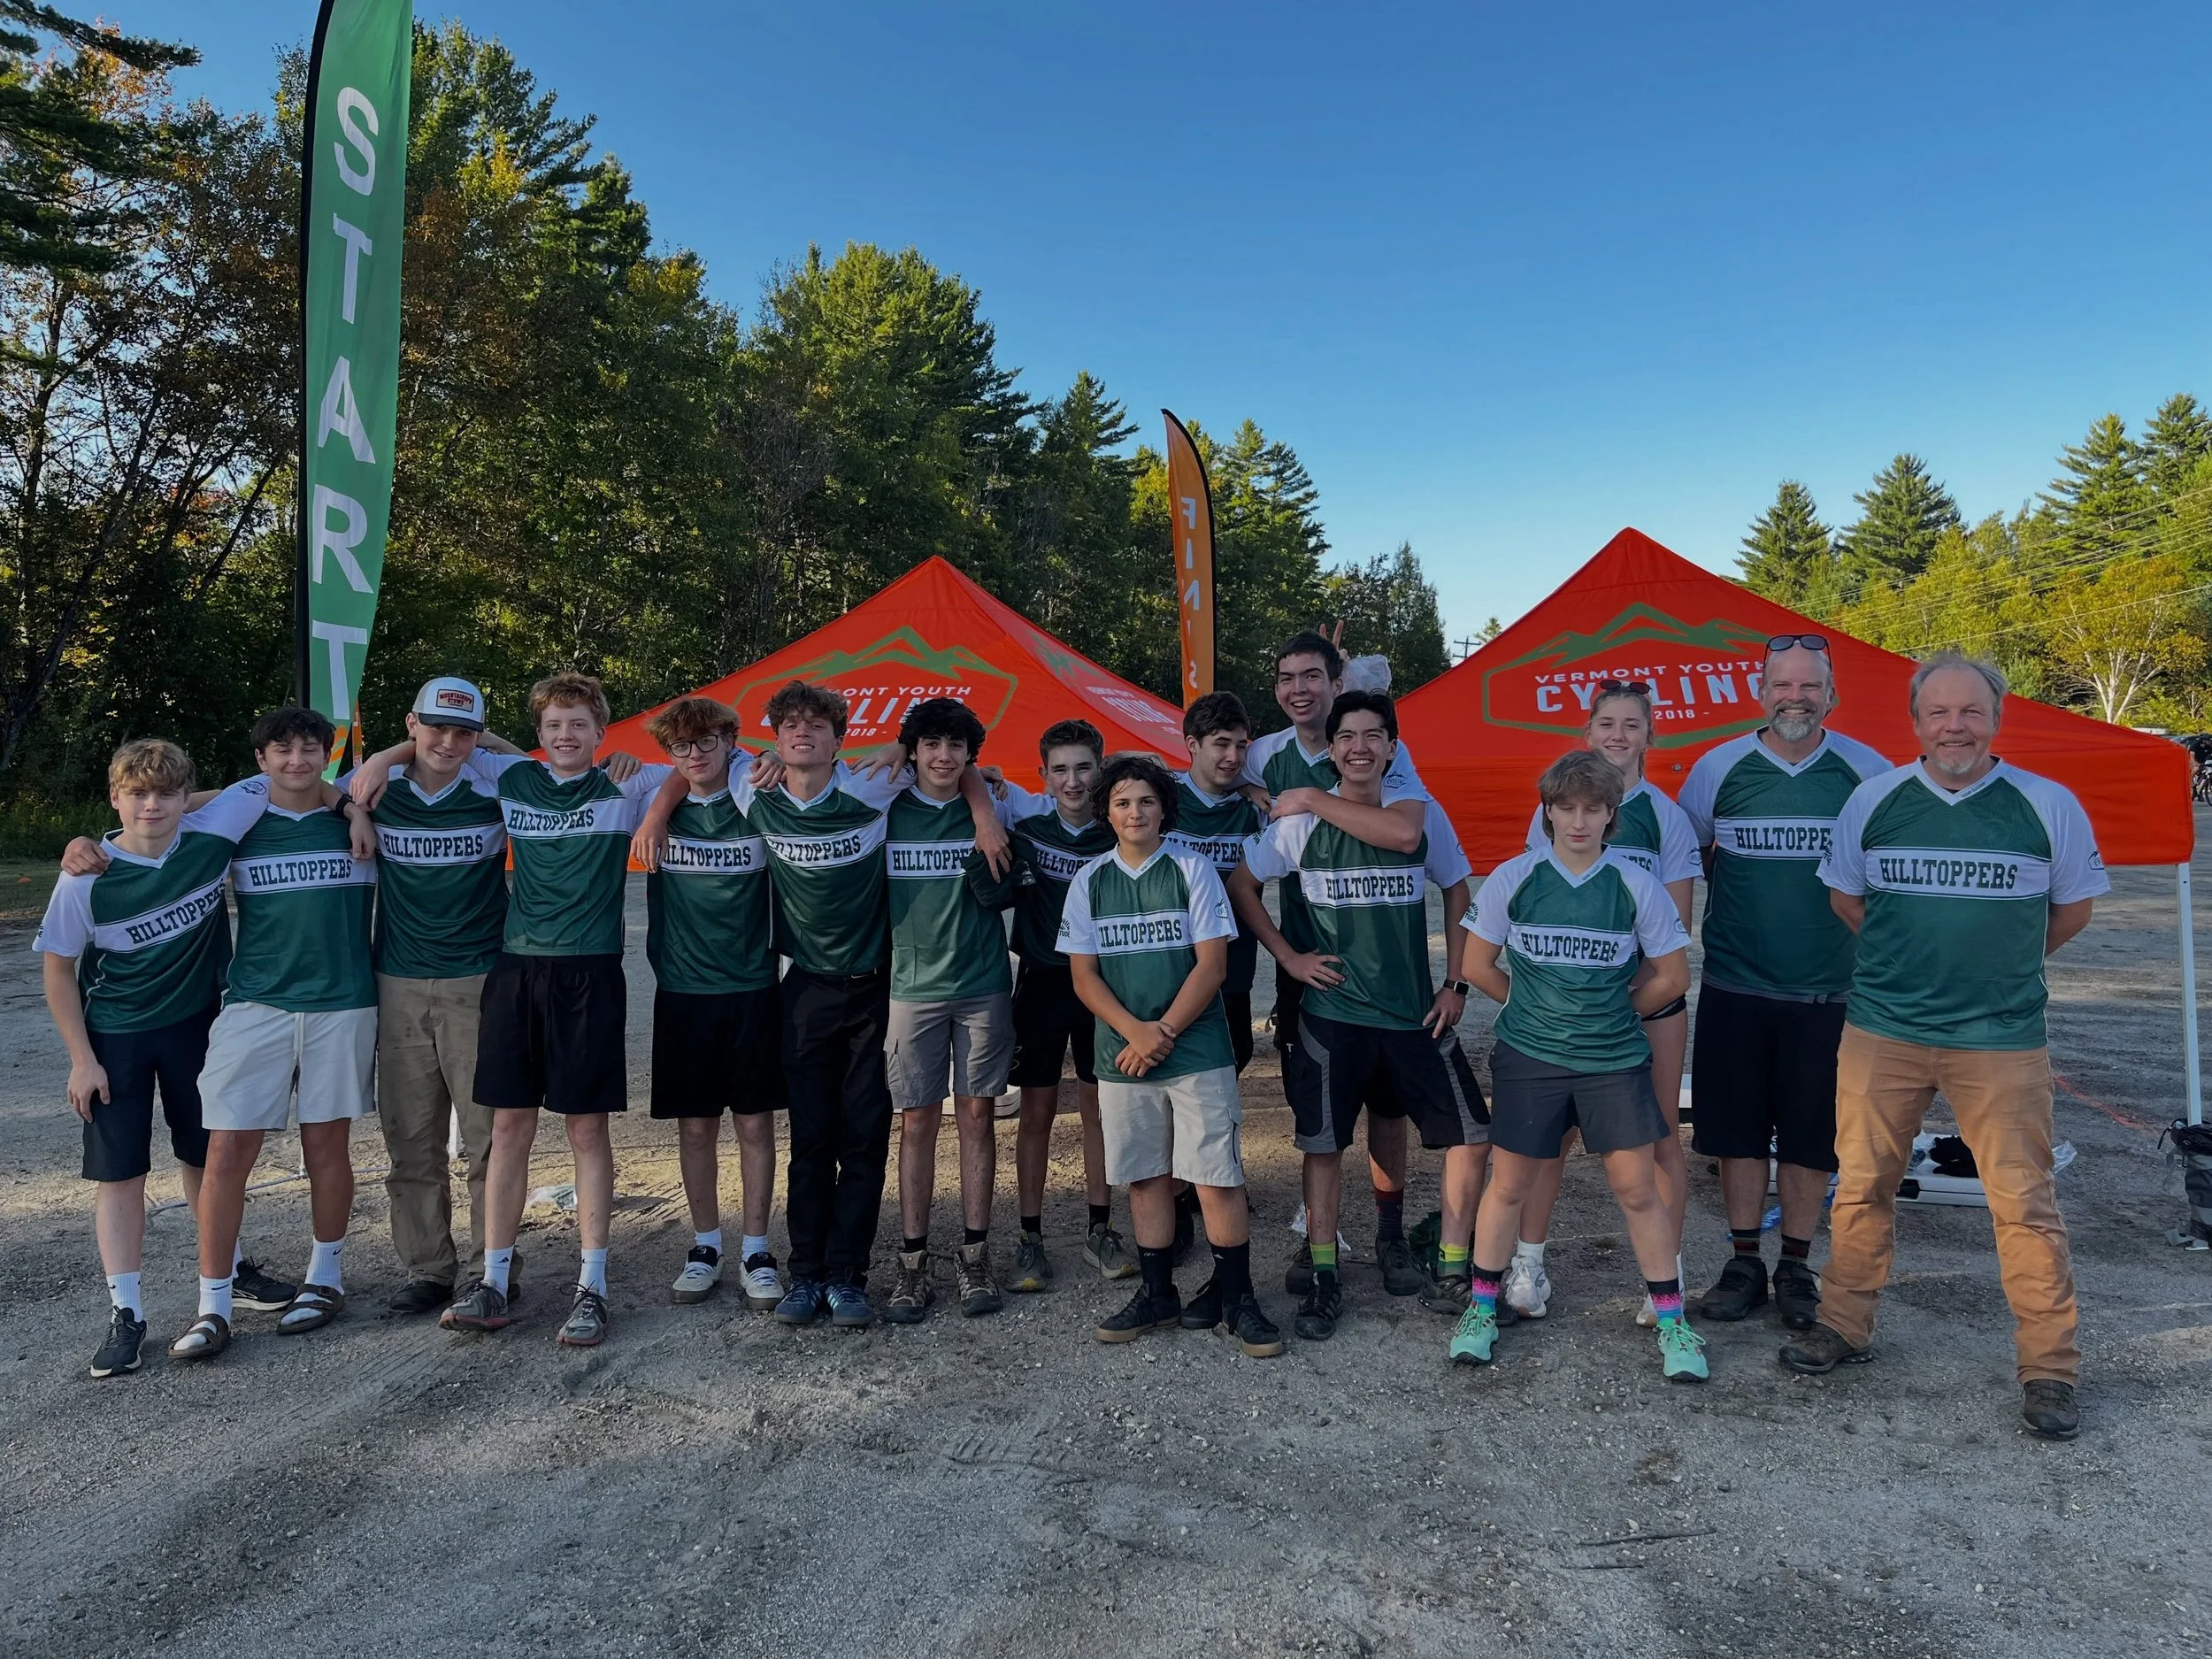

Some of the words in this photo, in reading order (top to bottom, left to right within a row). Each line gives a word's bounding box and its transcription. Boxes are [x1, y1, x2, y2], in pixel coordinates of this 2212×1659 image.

[311, 87, 380, 720] START
[1535, 665, 1667, 684] VERMONT
[898, 686, 972, 696] YOUTH
[1654, 709, 1696, 720] 2018
[506, 808, 595, 831] HILLTOPPERS
[383, 833, 483, 858] HILLTOPPERS
[1734, 826, 1834, 850] HILLTOPPE
[249, 858, 353, 886] HILLTOPPERS
[1879, 857, 2018, 890] HILLTOPPERS
[1325, 874, 1415, 900] HILLTOPPERS
[1520, 932, 1619, 962] HILLTOPPERS
